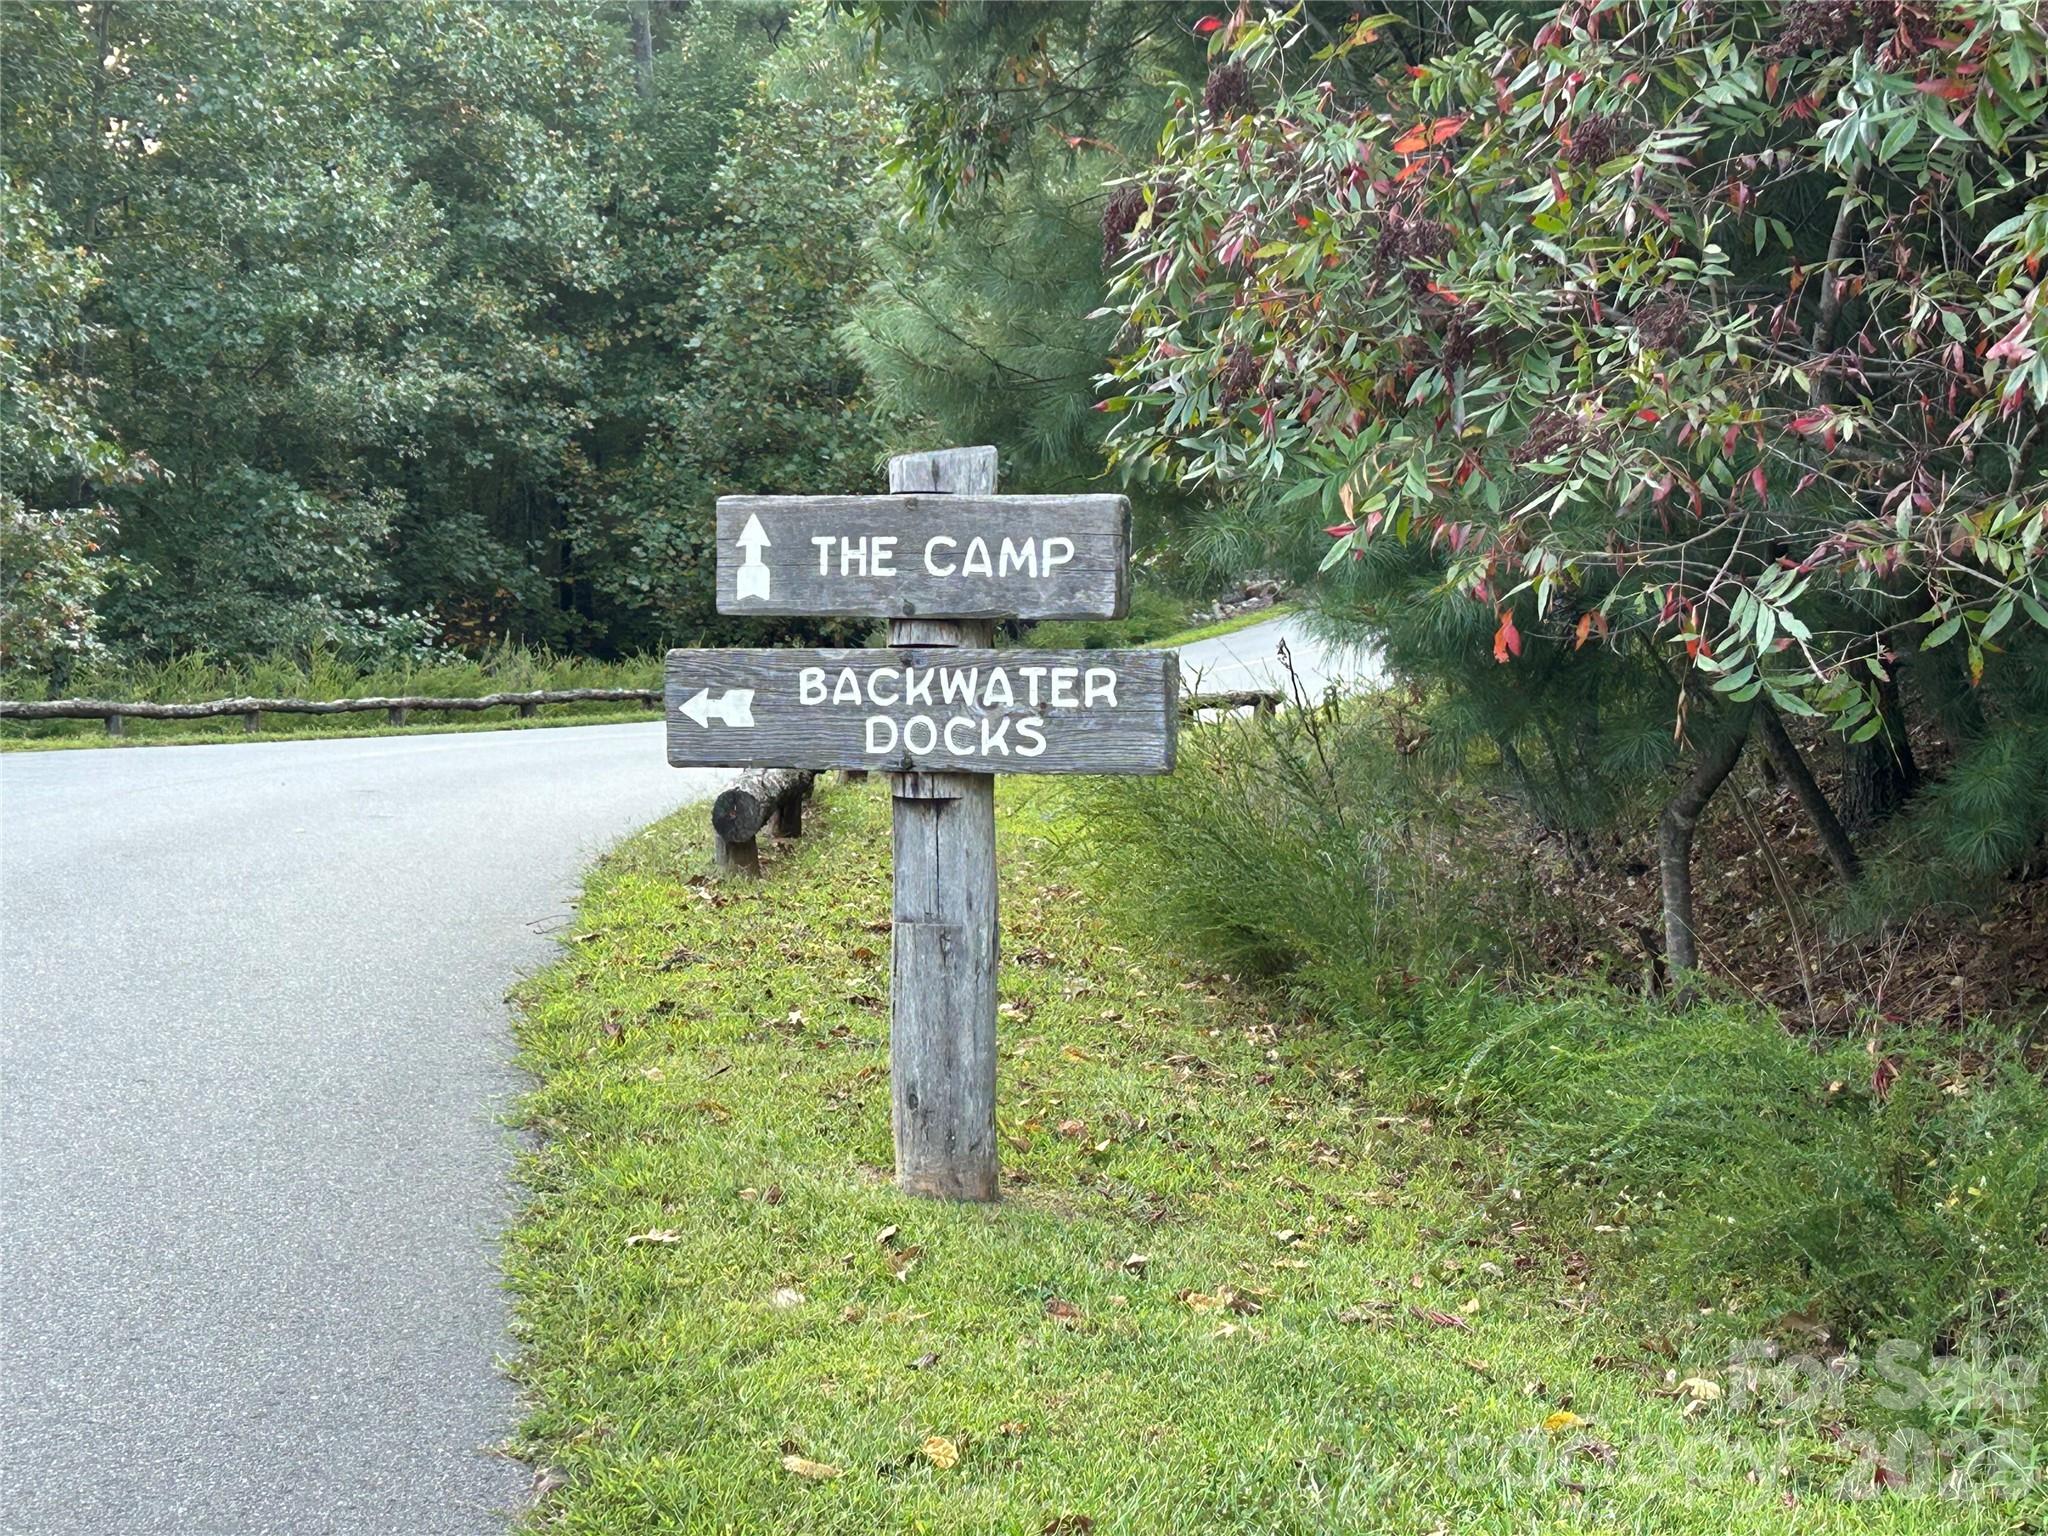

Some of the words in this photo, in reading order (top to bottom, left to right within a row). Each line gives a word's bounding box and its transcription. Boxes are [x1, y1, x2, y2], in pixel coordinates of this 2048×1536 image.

[812, 537, 897, 576] THE
[924, 536, 1074, 577] CAMP
[800, 667, 1117, 708] BACKWATER
[866, 715, 1046, 756] DOCKS
